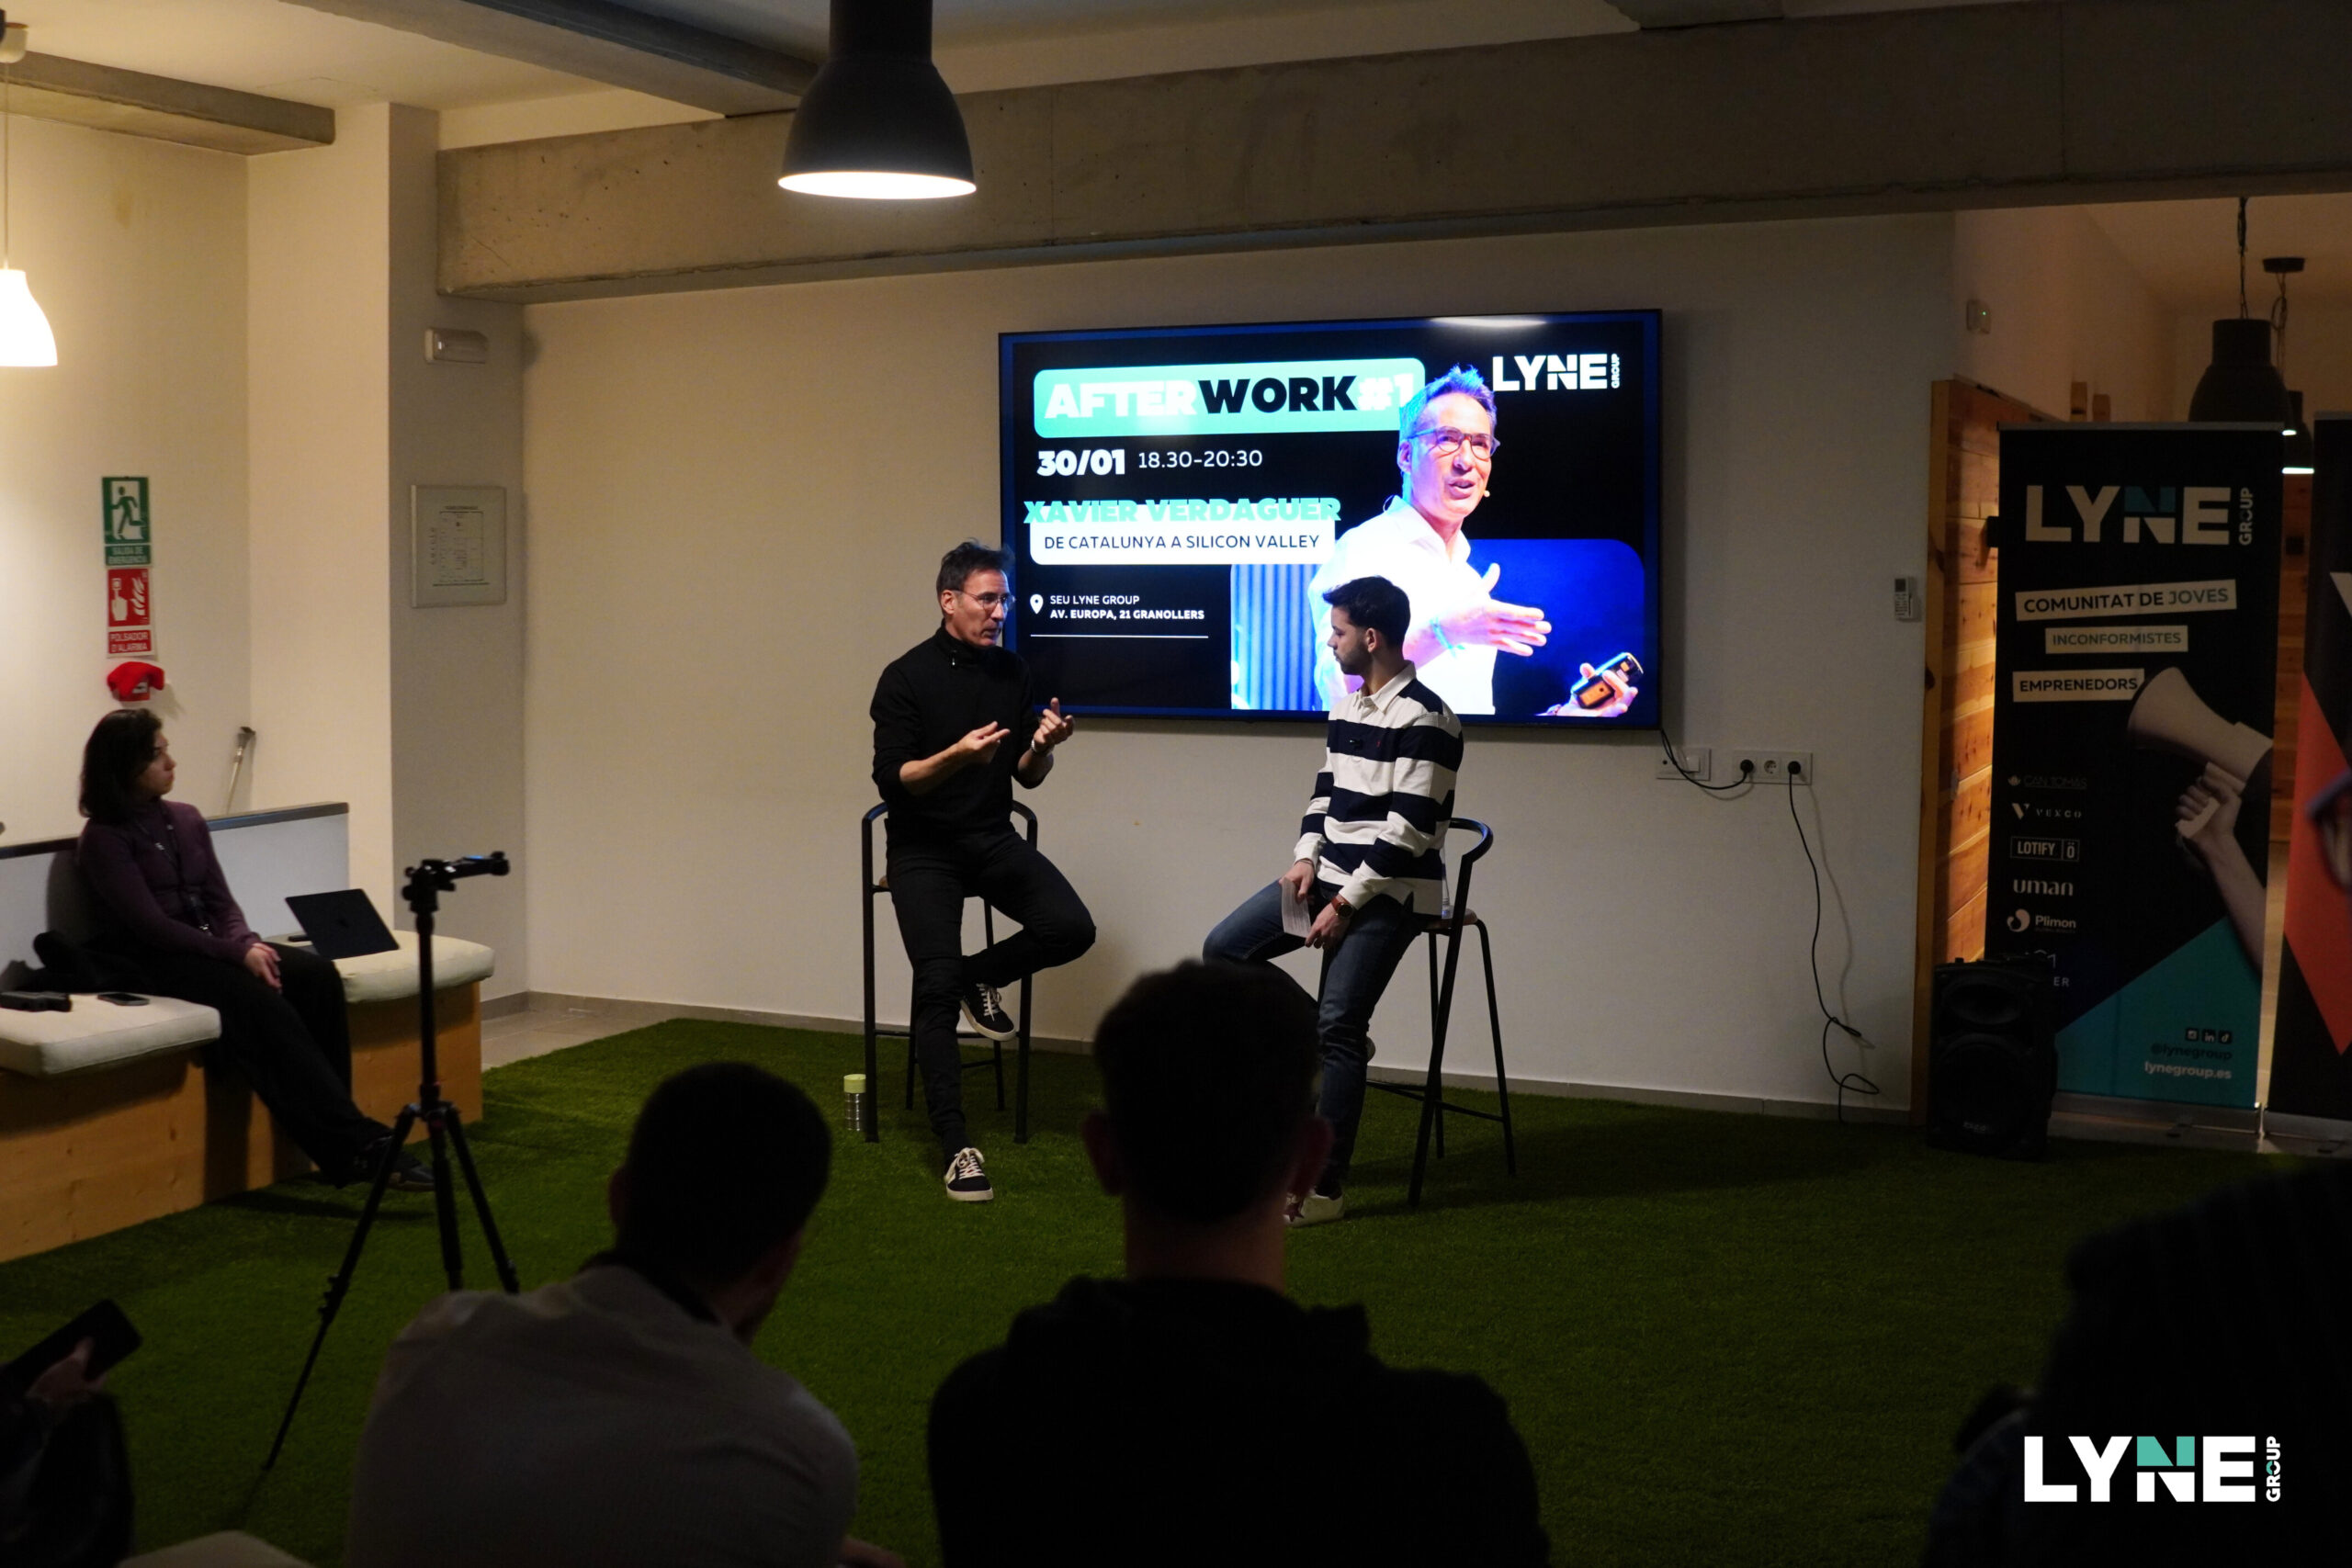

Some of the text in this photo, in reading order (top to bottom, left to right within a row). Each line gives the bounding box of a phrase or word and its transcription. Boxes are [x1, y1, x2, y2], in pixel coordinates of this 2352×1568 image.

[1492, 353, 1621, 391] LYNE GROUP
[1036, 448, 1262, 477] 30/01 18.30-20:30
[1023, 497, 1341, 524] XAVIER VERDAGUER
[2025, 484, 2255, 546] LYNE GROUP
[1045, 535, 1320, 549] DE CATALUNYA A SILICON VALLEY
[1049, 595, 1140, 604] SEU LYNE GROUP
[2023, 588, 2229, 613] COMUNITAT DE JOVES
[1049, 609, 1205, 621] AV. EUROPA, 21 GRANOLLERS
[2052, 632, 2182, 646] INCONFORMISTES
[2019, 678, 2138, 693] EMPRENEDORS
[2017, 840, 2055, 856] LOTIFY
[2013, 878, 2074, 897] uman
[2035, 914, 2077, 929] Plimon
[2151, 1043, 2233, 1061] @lynegroup
[2144, 1061, 2233, 1079] lynegroup.es
